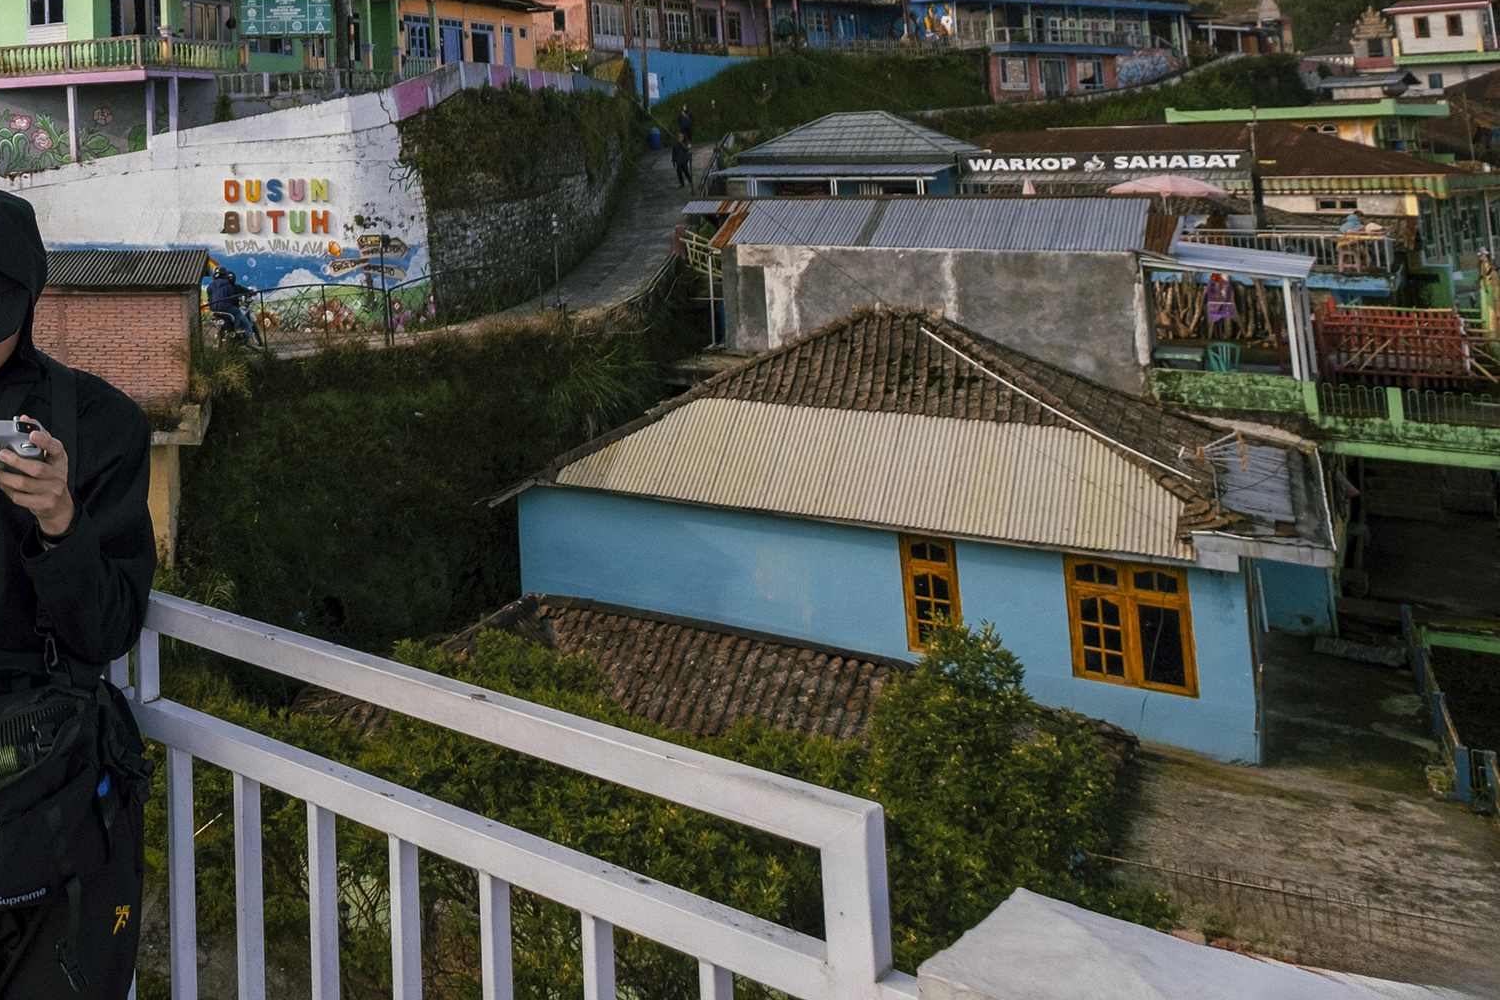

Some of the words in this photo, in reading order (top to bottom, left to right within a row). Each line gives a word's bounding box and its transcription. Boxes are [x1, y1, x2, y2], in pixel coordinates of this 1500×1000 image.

[968, 157, 1077, 172] WARKOP
[1113, 154, 1241, 170] SAHABAT
[224, 178, 329, 203] DUSUN
[224, 210, 329, 235] BUTUH
[224, 239, 266, 255] NEPAL
[267, 239, 290, 253] VAN
[292, 240, 323, 256] JAVA
